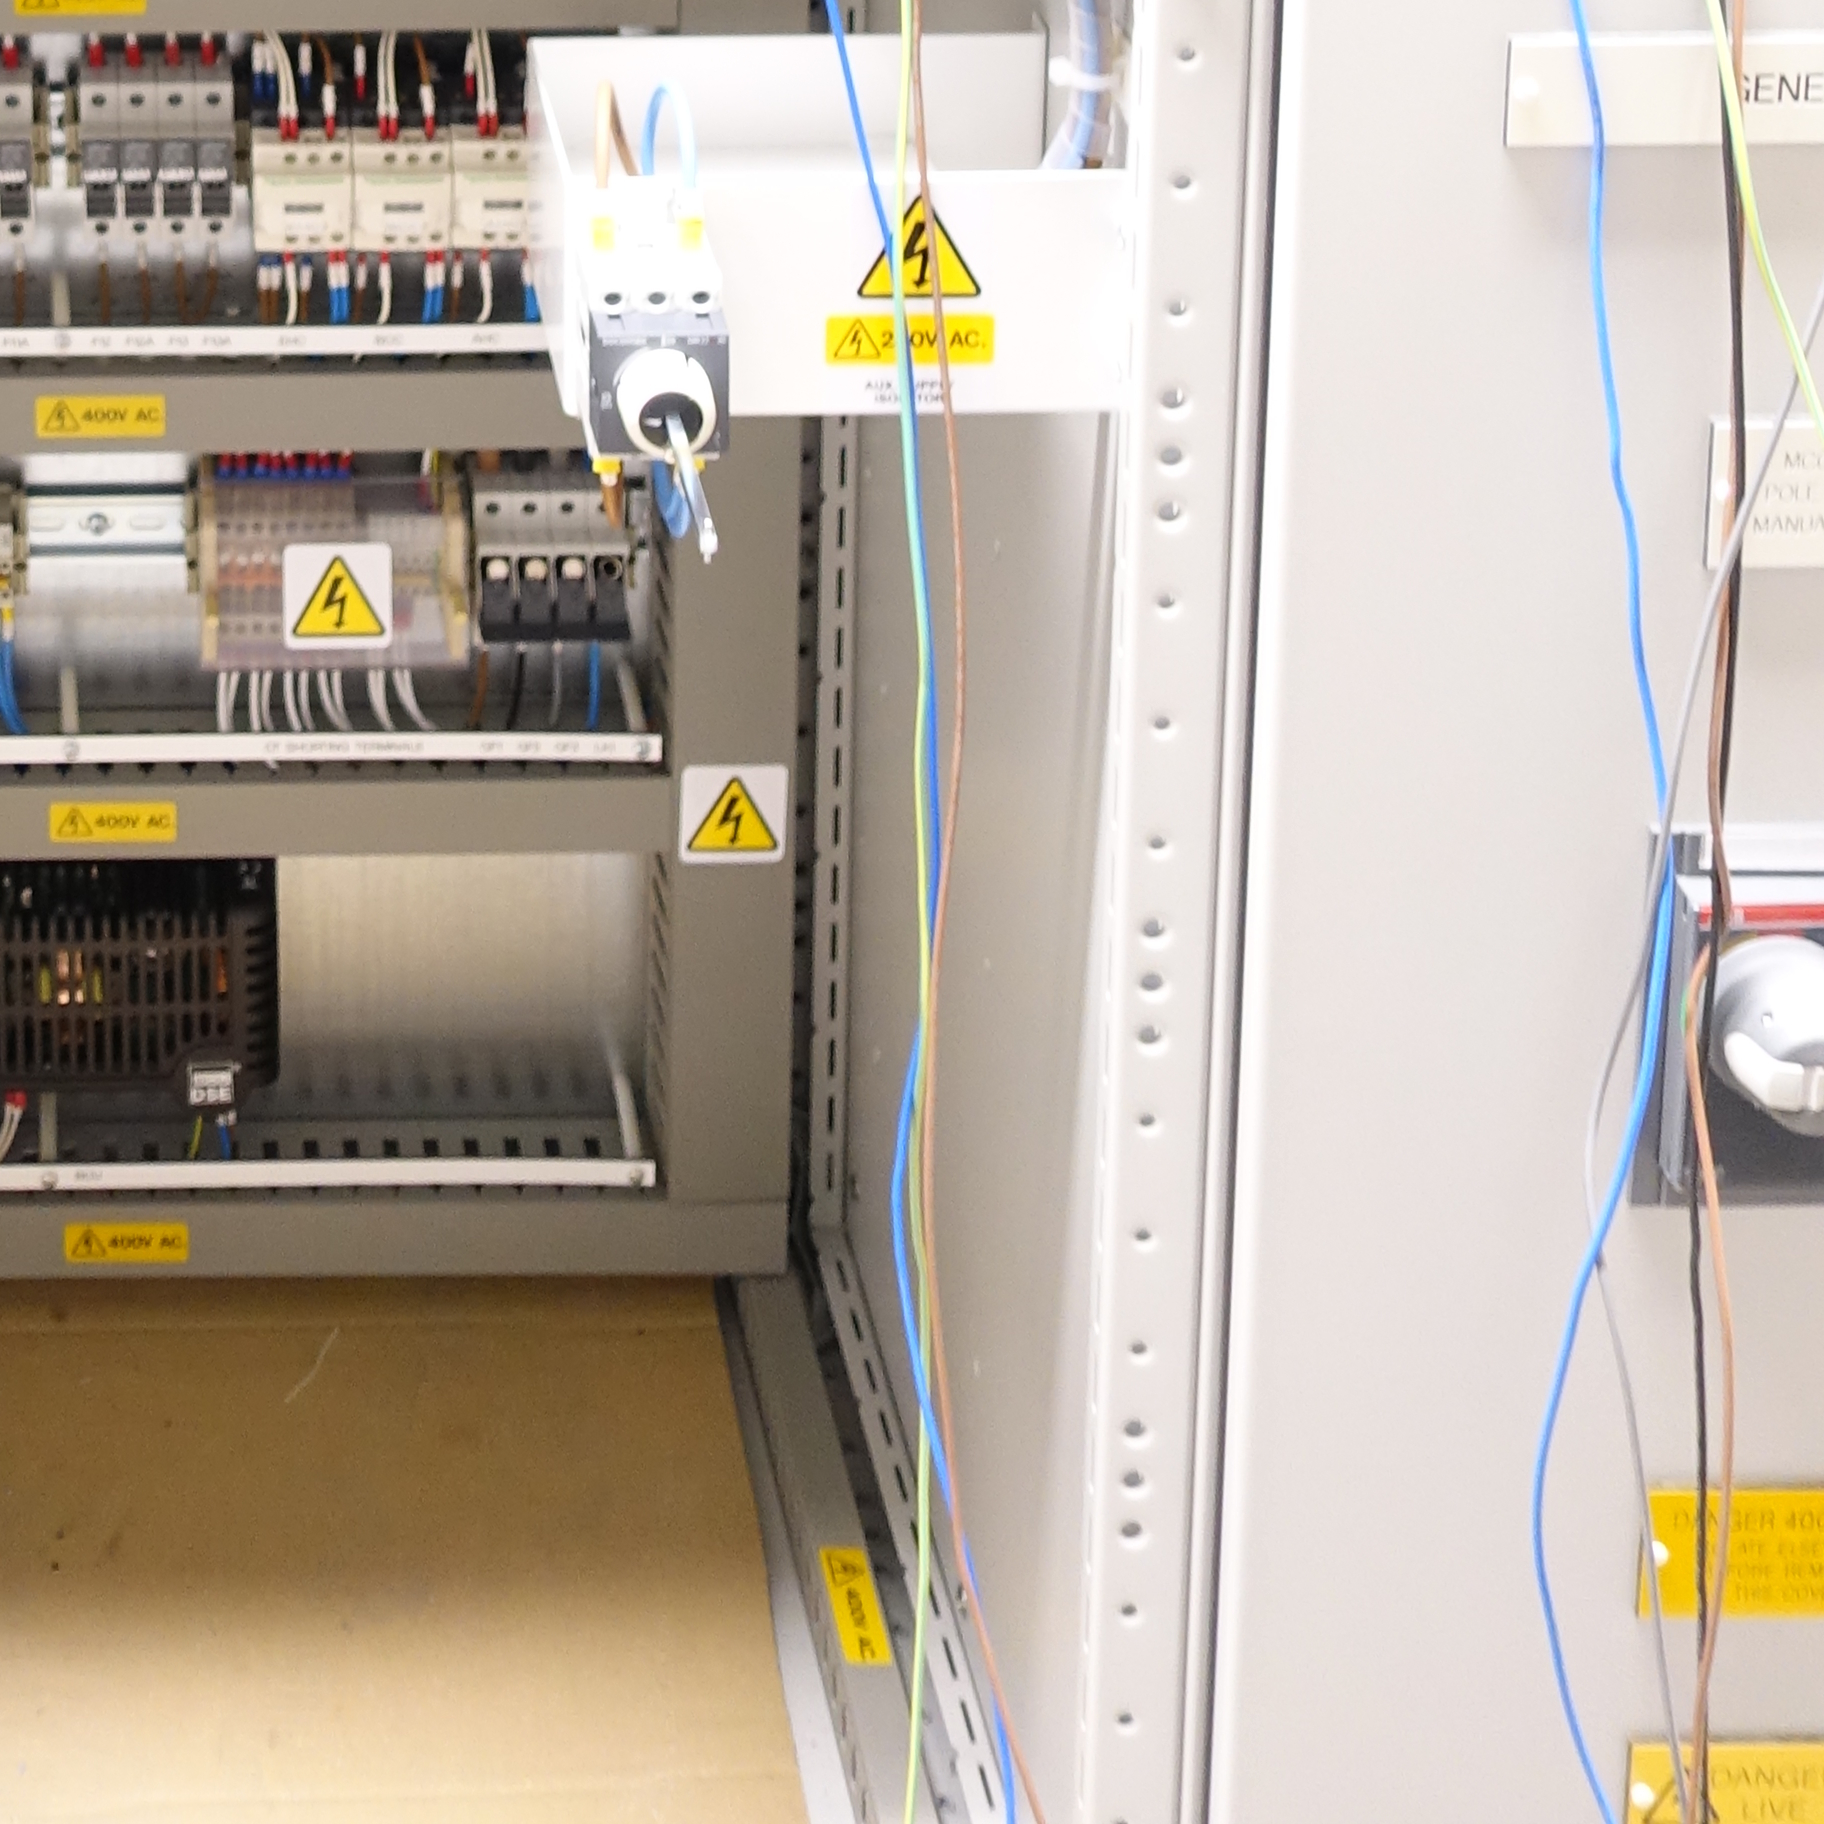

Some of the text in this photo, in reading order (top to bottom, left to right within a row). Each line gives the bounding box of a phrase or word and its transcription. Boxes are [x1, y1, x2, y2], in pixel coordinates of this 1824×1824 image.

[881, 329, 939, 349] 20V
[82, 409, 128, 422] 400V
[95, 815, 140, 829] 400V
